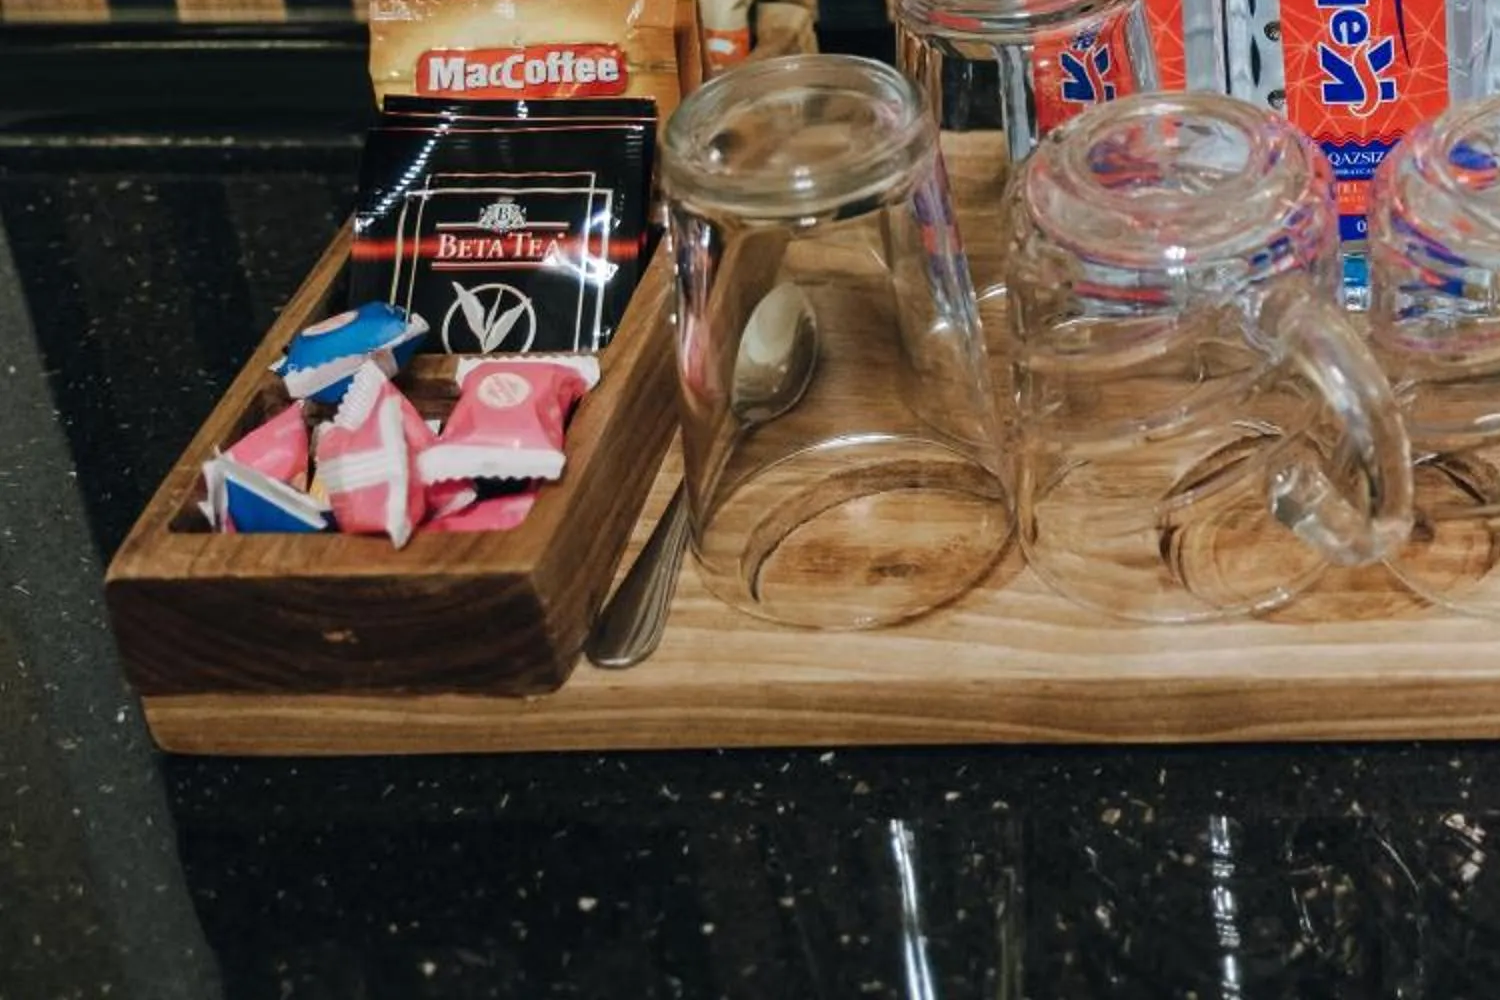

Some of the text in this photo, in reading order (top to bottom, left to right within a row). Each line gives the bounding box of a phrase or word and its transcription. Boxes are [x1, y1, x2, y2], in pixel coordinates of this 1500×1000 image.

[428, 51, 619, 91] MacCoffee
[1327, 151, 1385, 166] QAZSIZ
[436, 231, 562, 259] BETA TEA
